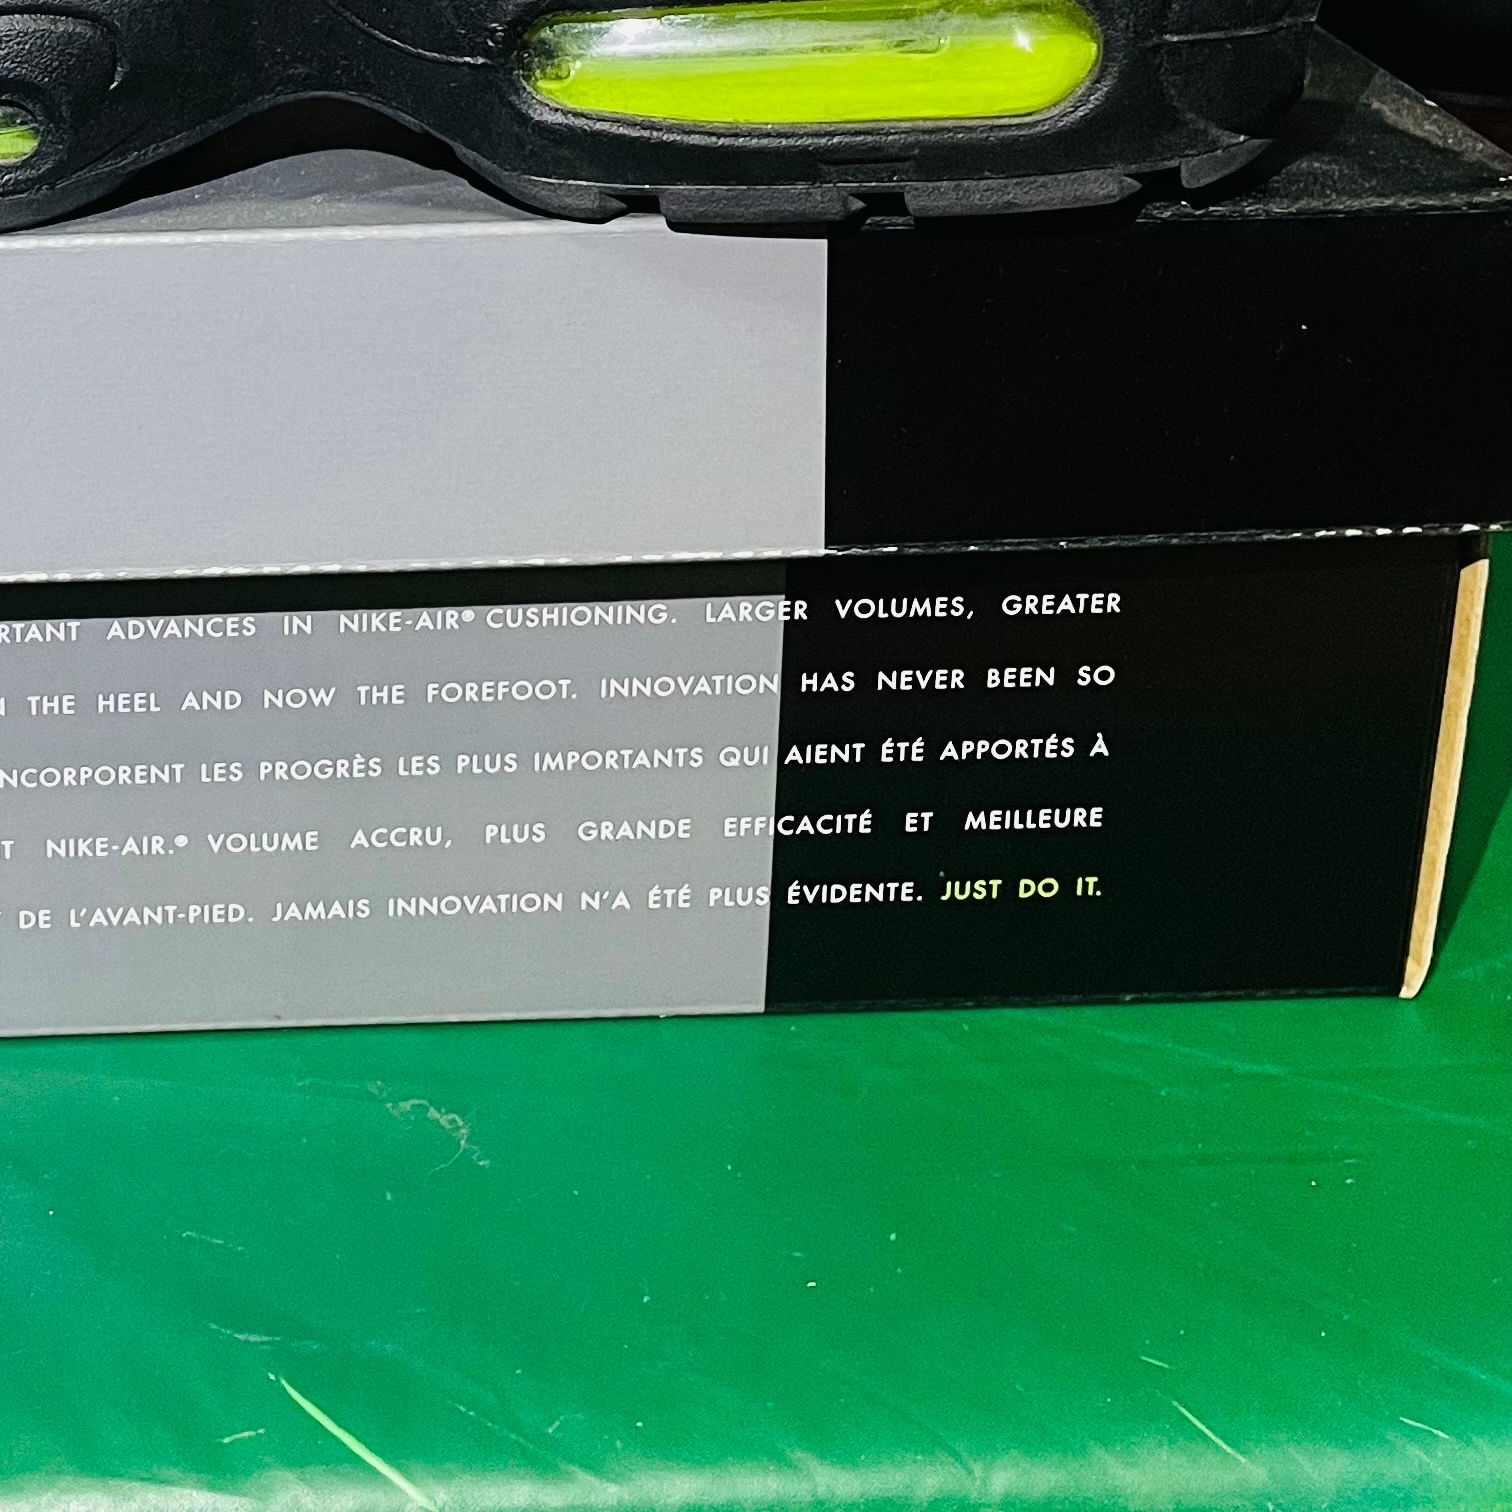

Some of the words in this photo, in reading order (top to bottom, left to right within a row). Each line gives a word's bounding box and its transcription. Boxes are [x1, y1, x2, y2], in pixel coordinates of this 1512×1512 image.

[106, 616, 256, 640] ADVANCES
[283, 614, 312, 636] IN
[486, 603, 677, 629] CUSHIONING.
[706, 600, 808, 623] LARGER
[834, 595, 974, 620] VOLUMES,
[1001, 592, 1121, 616] GREATER
[27, 694, 75, 716] THE
[98, 692, 161, 714] HEEL
[181, 690, 242, 711] AND
[264, 687, 336, 709] NOW
[356, 684, 405, 706] THE
[427, 679, 577, 703] FOREFOOT.
[601, 673, 779, 698] INNOVATION
[801, 671, 855, 693] HAS
[877, 668, 965, 691] NEVER
[986, 666, 1055, 689] BEEN
[1076, 664, 1116, 687] SO
[201, 762, 243, 783] LES
[259, 753, 382, 781] PROGRÈS
[398, 755, 441, 776] LES
[457, 753, 518, 774] PLUS
[534, 747, 703, 772] IMPORTANTS
[719, 745, 769, 767] QUI
[785, 742, 866, 764] AIENT
[880, 736, 925, 763] ÉTÉ
[939, 733, 1075, 761] APPORTÉS
[1089, 732, 1110, 757] À
[207, 830, 319, 853] VOLUME
[350, 826, 452, 849] ACCRU,
[485, 822, 546, 844] PLUS
[577, 818, 691, 842] GRANDE
[724, 808, 873, 837] EFFICACITÉ
[905, 811, 934, 833] ET
[964, 806, 1104, 831] MEILLEURE
[19, 909, 52, 930] DE
[68, 903, 254, 928] L’AVANT-PIED.
[271, 898, 370, 922] JAMAIS
[388, 892, 563, 917] INNOVATION
[580, 890, 631, 911] N’A
[648, 883, 691, 909] ÉTÉ
[709, 885, 770, 907] PLUS
[788, 880, 923, 905] ÉVIDENTE.
[940, 879, 1003, 901] JUST
[1018, 877, 1060, 899] DO
[1076, 876, 1102, 897] IT.
